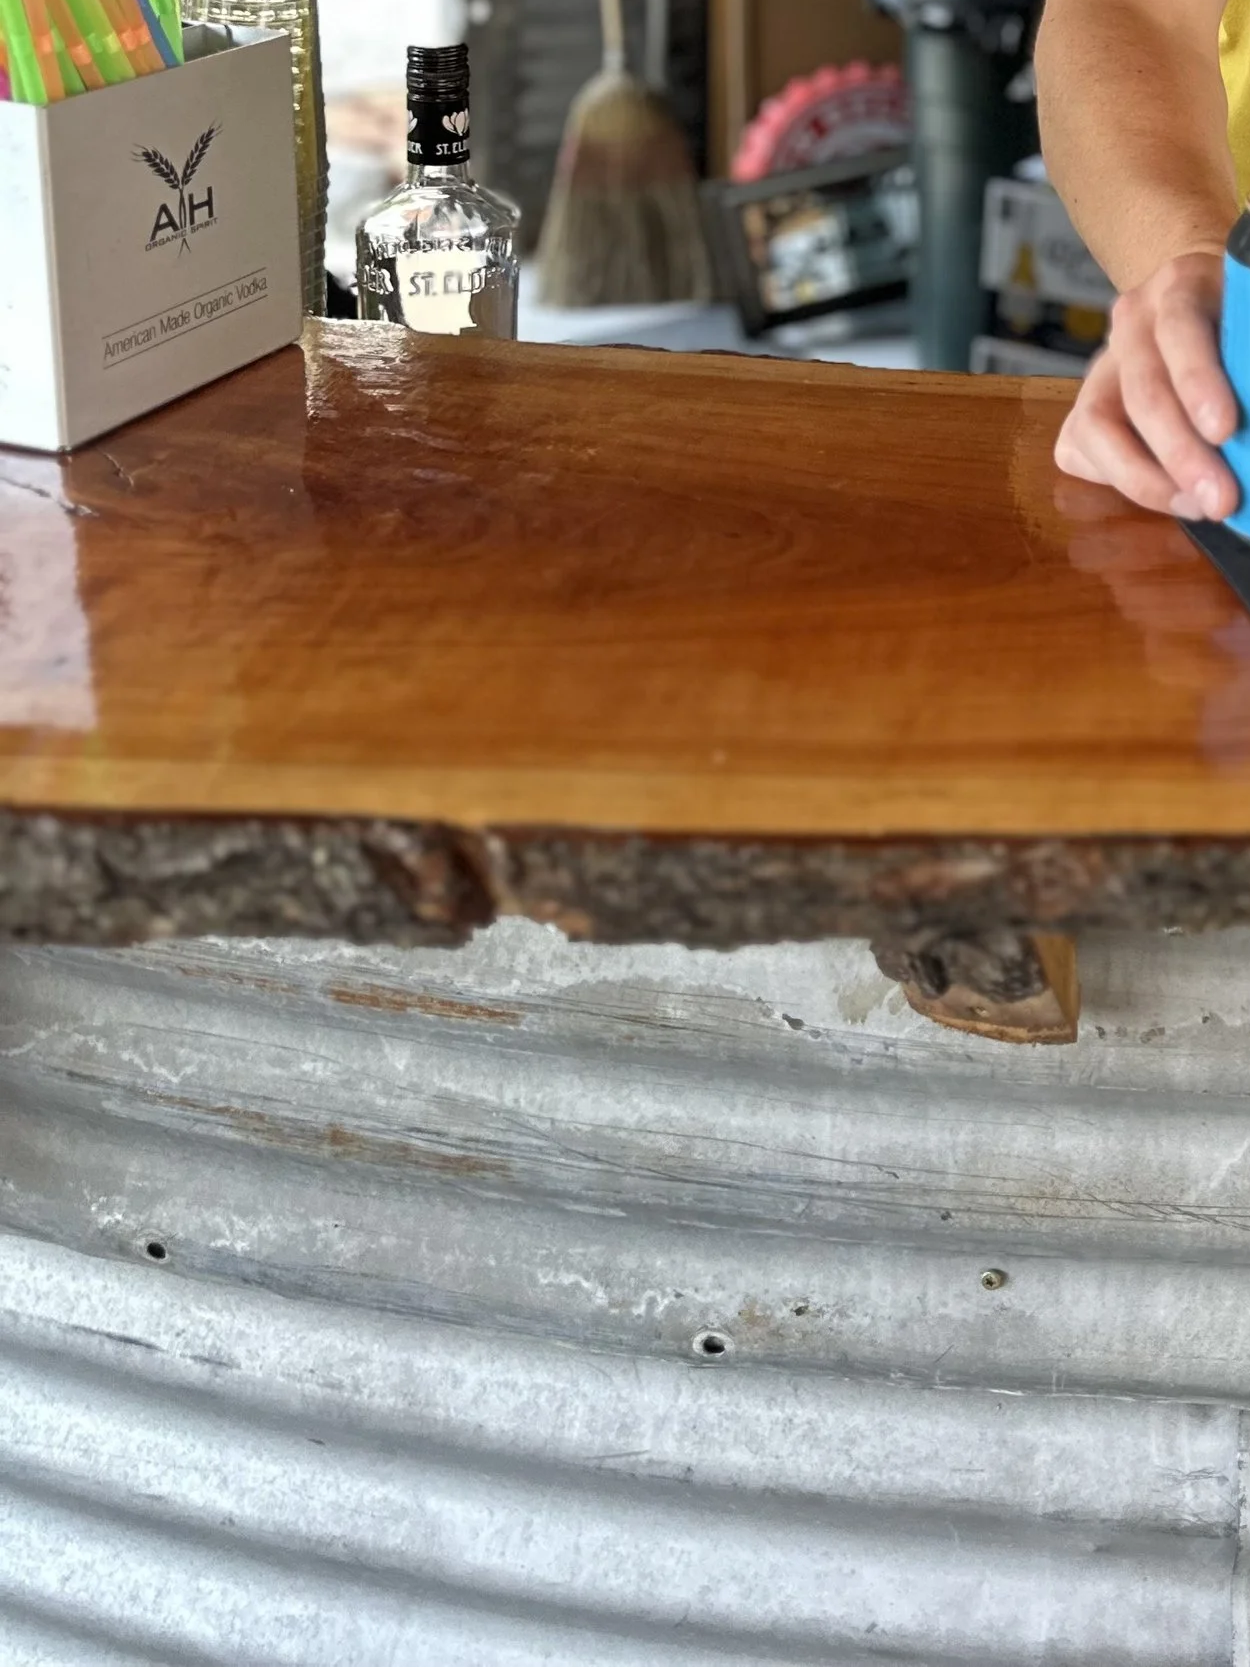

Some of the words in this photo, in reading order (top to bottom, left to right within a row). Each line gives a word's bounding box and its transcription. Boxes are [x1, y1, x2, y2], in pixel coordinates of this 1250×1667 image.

[435, 142, 451, 156] ST.
[145, 227, 187, 252] ORGANIC
[190, 217, 219, 234] SPIRIT
[103, 325, 157, 361] American
[159, 310, 191, 335] Made
[193, 291, 234, 320] Organic
[236, 276, 269, 302] Vodka
